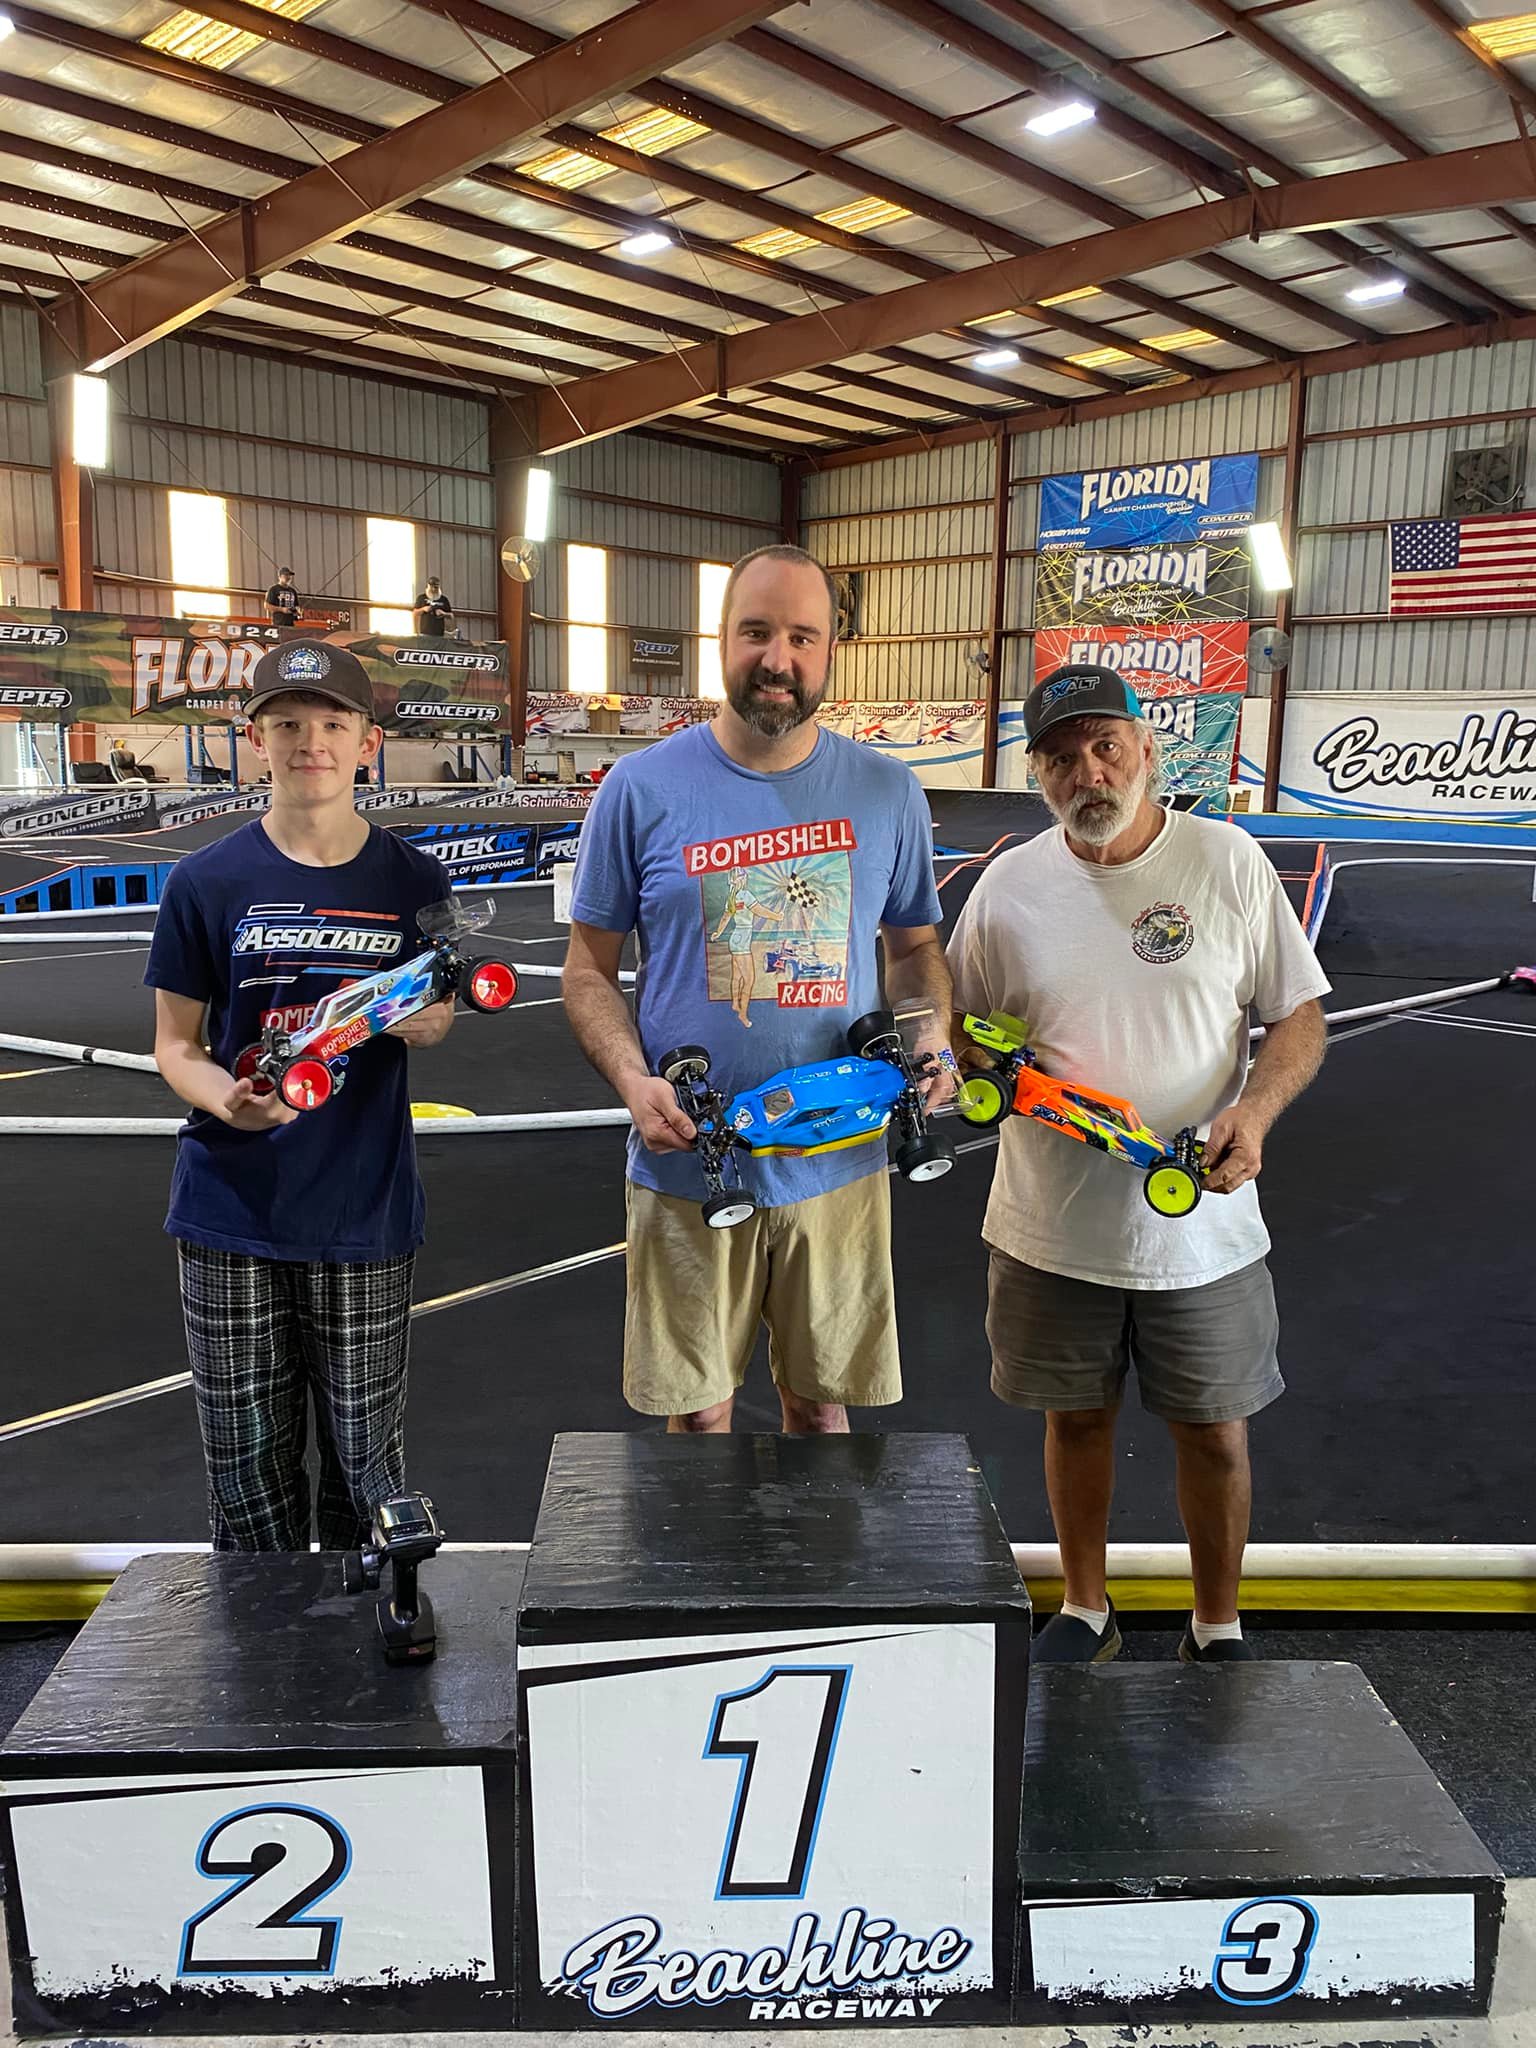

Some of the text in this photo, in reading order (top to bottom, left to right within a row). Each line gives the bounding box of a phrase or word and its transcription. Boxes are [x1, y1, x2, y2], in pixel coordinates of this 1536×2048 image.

[1081, 460, 1211, 521] FLORIDA
[1073, 548, 1208, 606] FLORIDA
[207, 623, 280, 639] 2024
[398, 651, 495, 669] JCONCEPTS
[1070, 636, 1204, 688] FLORIDA
[0, 689, 66, 704] EPTS
[186, 699, 224, 710] CARPET
[1042, 676, 1100, 708] EXALT
[400, 704, 497, 718] JCONCEPTS
[1313, 709, 1536, 793] Beachli
[1432, 784, 1536, 800] RACEW
[10, 792, 144, 834] JCONCEPTS
[690, 821, 853, 873] BOMBSHELL
[459, 866, 471, 876] OF
[472, 856, 525, 873] PERFORMANCE
[239, 926, 402, 954] ASSOCIATED
[780, 982, 845, 1005] RACING
[320, 1016, 370, 1058] BOMBSHELL
[1031, 1104, 1070, 1126] EXALT
[701, 1664, 854, 1901] 1
[177, 1801, 353, 1977] 2
[562, 1906, 974, 2020] Beachline
[1210, 1895, 1320, 2006] 3
[748, 1998, 945, 2021] RACEWAY
